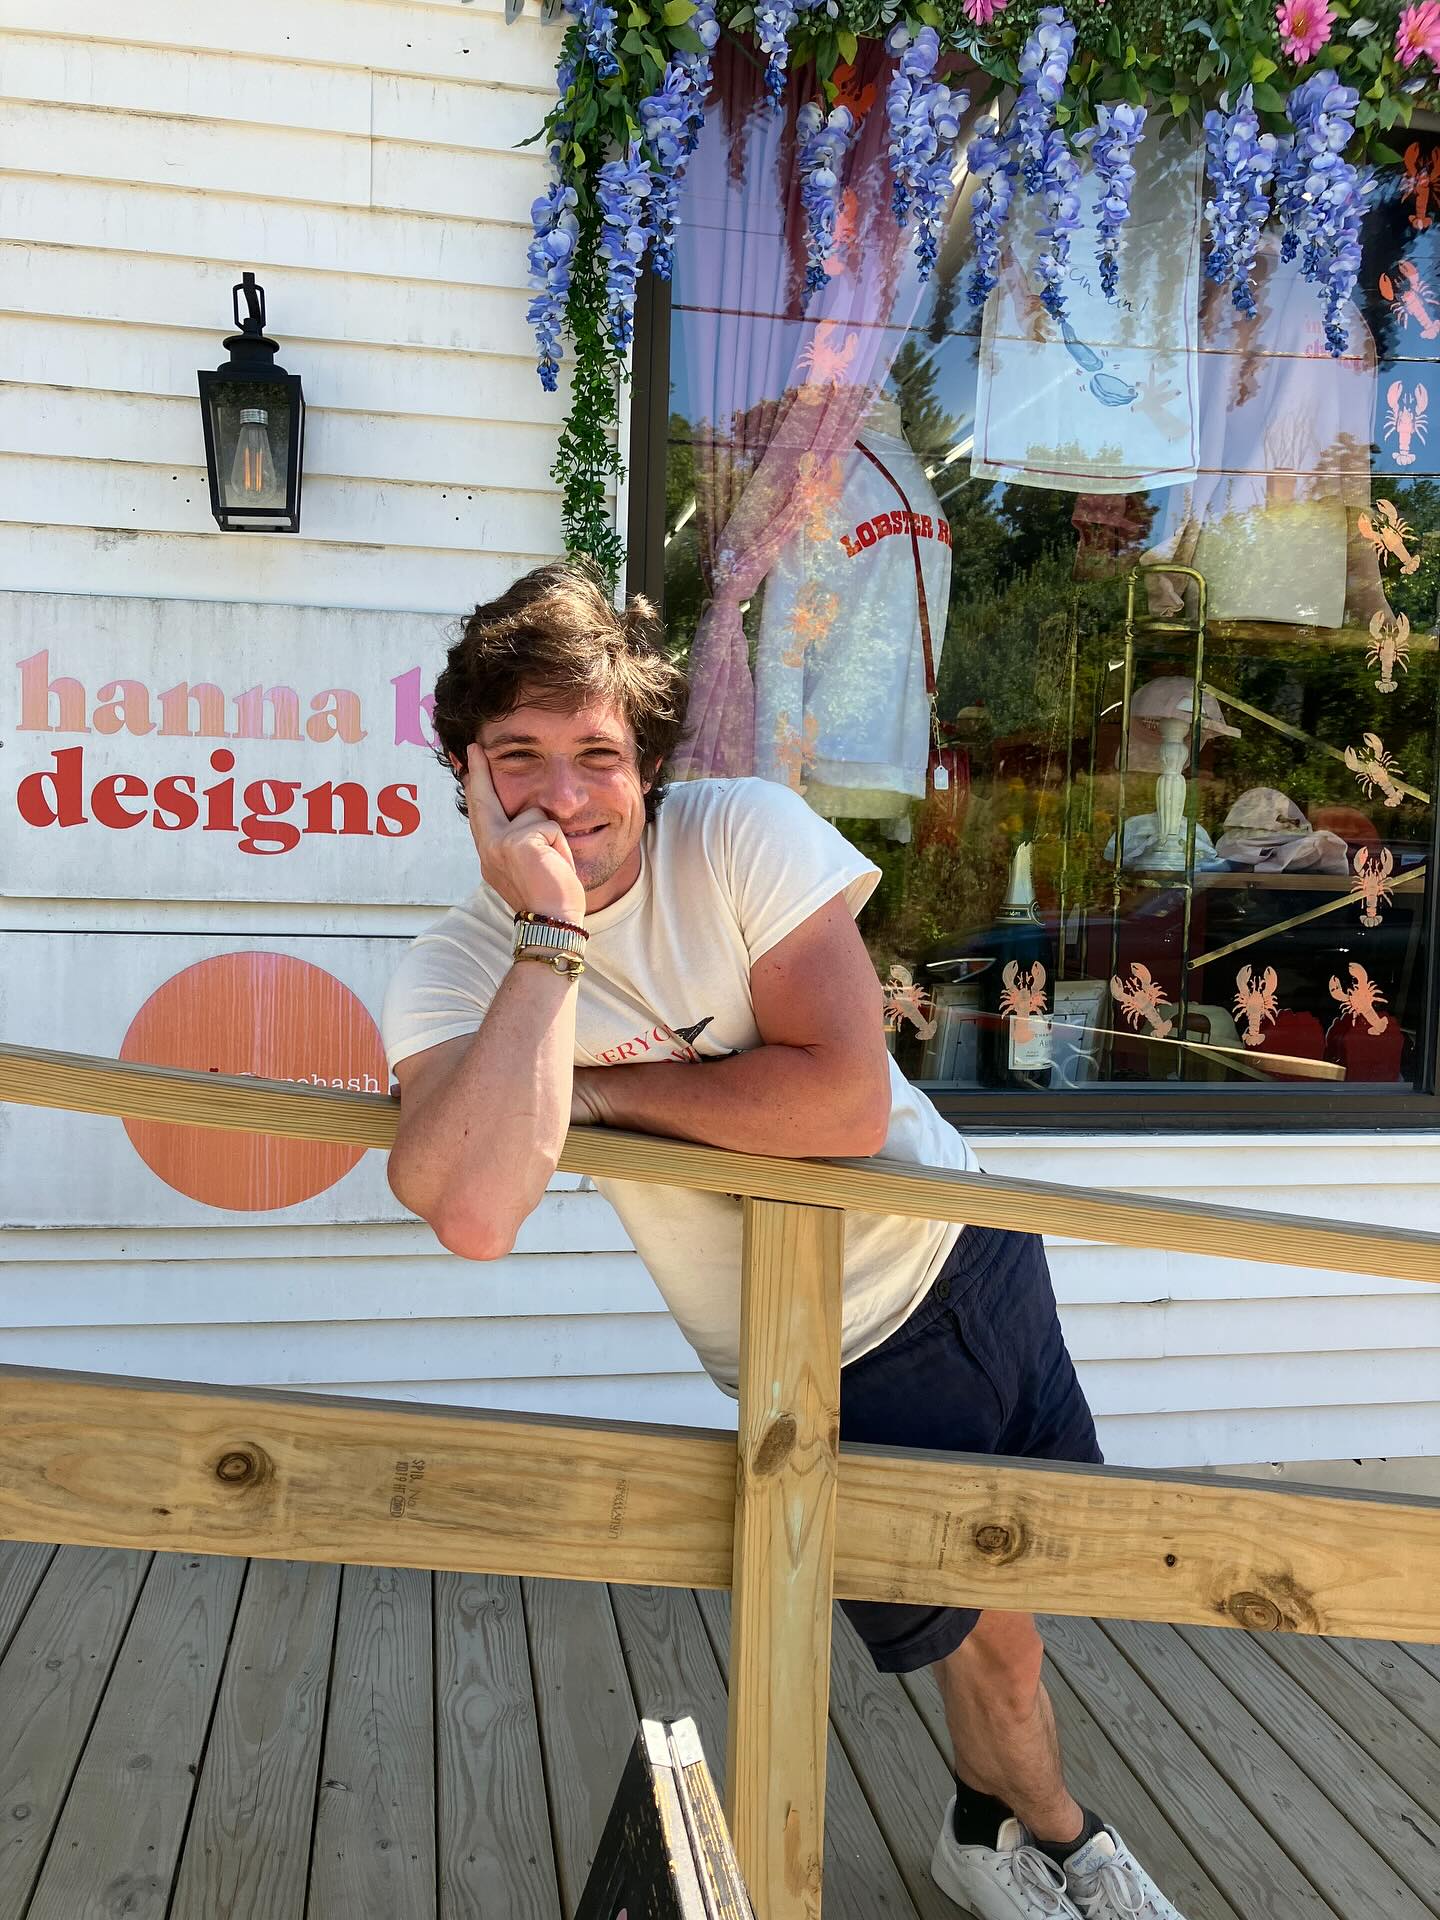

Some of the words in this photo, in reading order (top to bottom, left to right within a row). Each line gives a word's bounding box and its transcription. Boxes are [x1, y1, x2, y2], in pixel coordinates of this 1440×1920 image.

[839, 510, 934, 558] LOBSTER
[15, 649, 368, 744] hanna
[16, 746, 421, 855] designs
